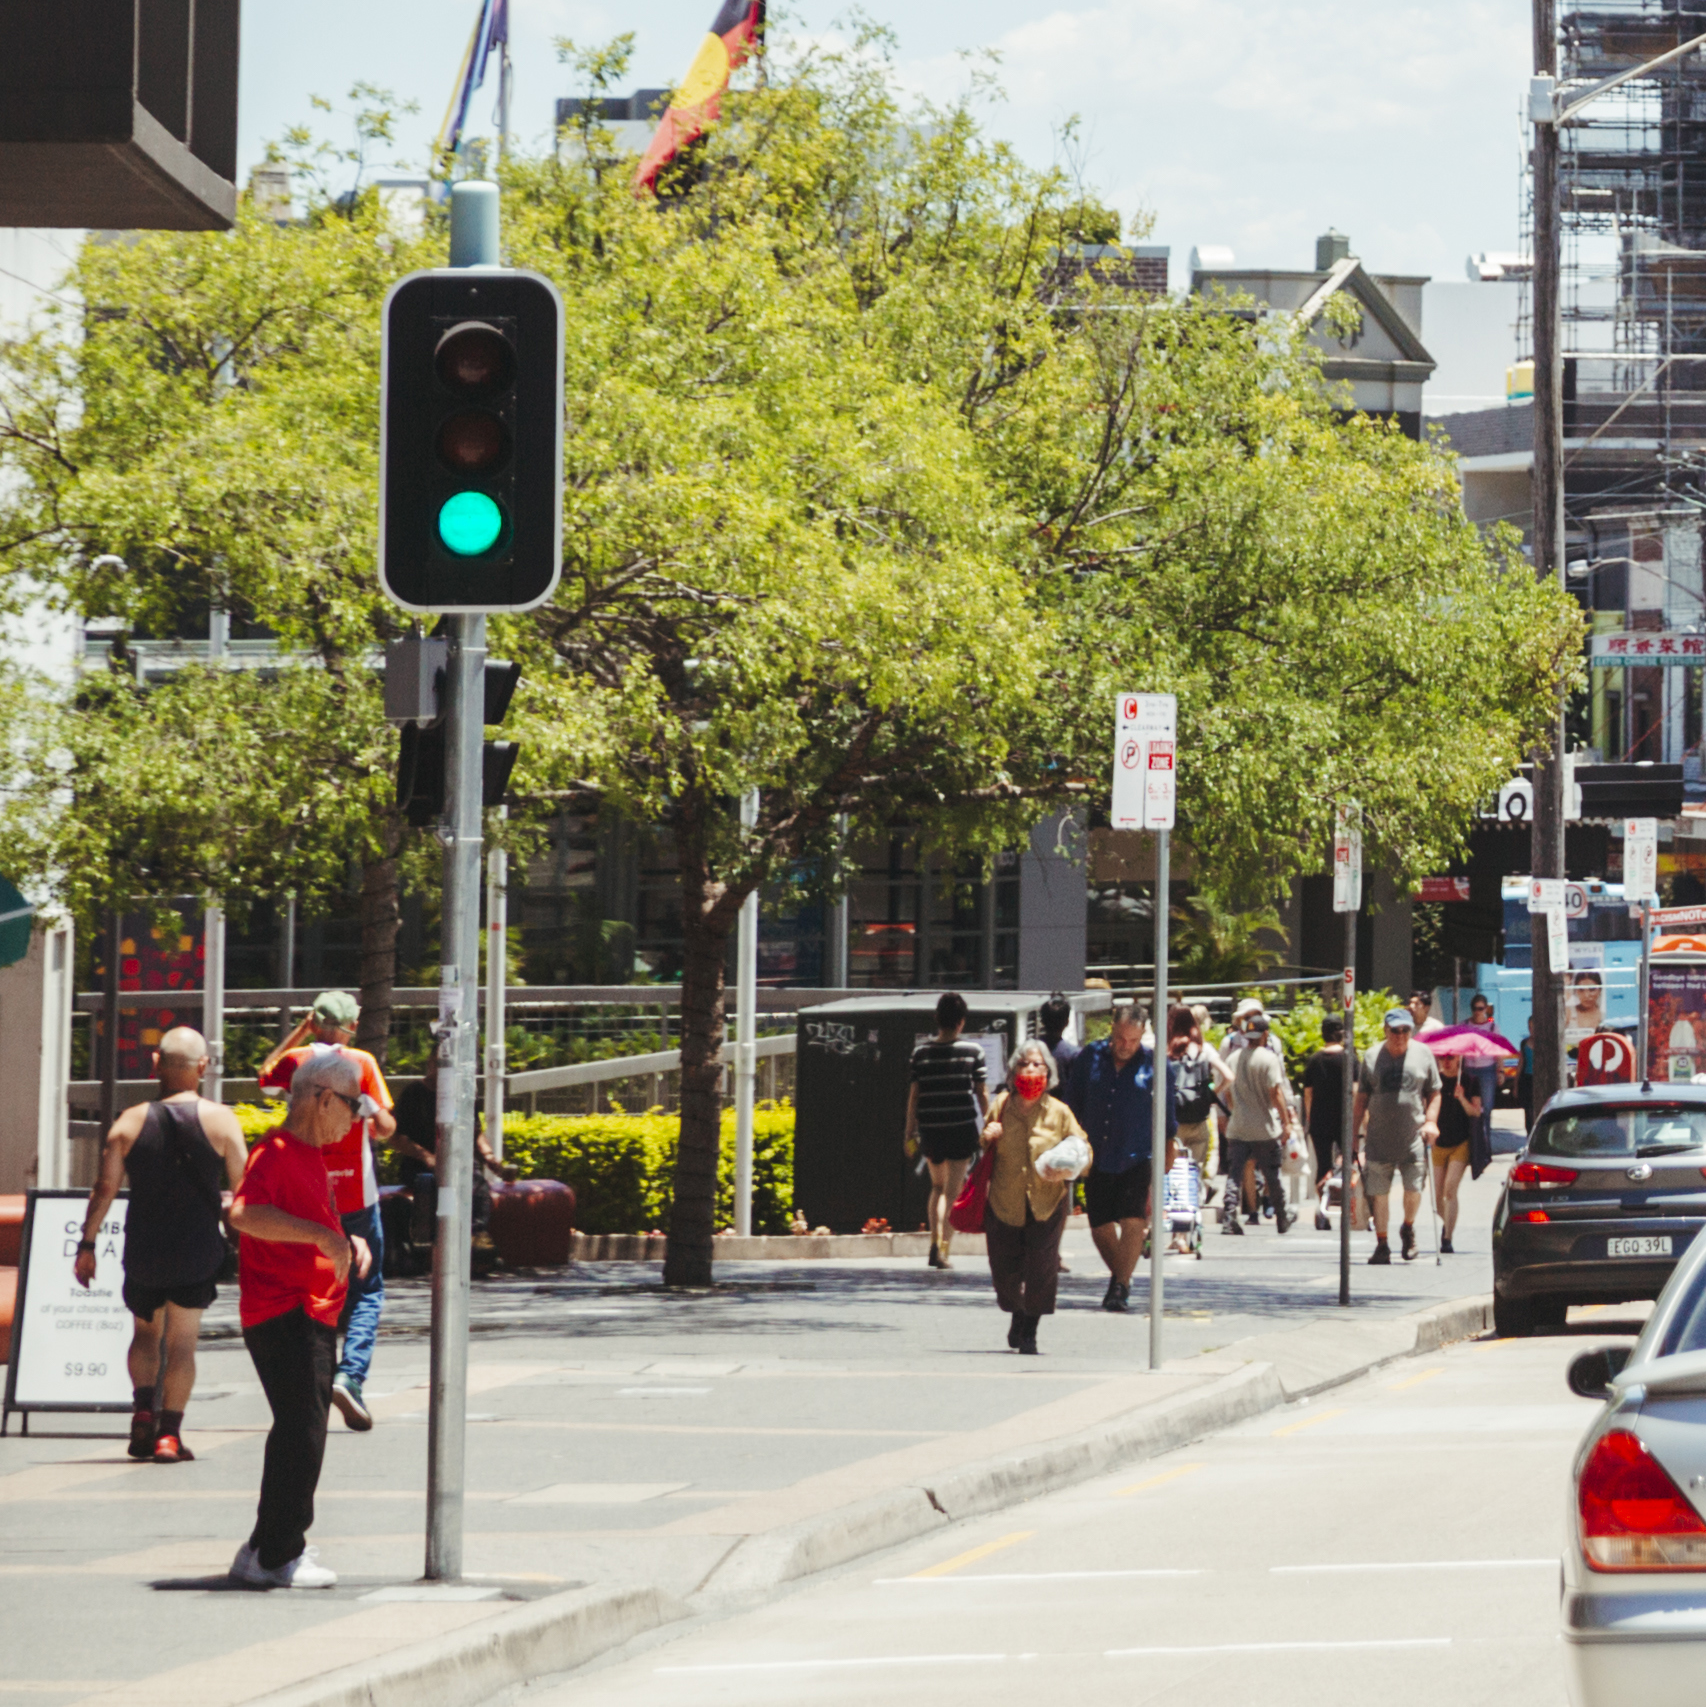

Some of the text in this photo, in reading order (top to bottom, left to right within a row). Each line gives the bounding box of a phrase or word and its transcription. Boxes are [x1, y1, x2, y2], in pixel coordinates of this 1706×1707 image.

[1124, 698, 1138, 720] C
[1151, 757, 1171, 769] ZONE
[70, 1287, 113, 1298] Toastie
[53, 1305, 75, 1316] your
[76, 1303, 110, 1314] choice
[56, 1320, 93, 1331] COFFEE
[64, 1362, 108, 1377] $9.90
